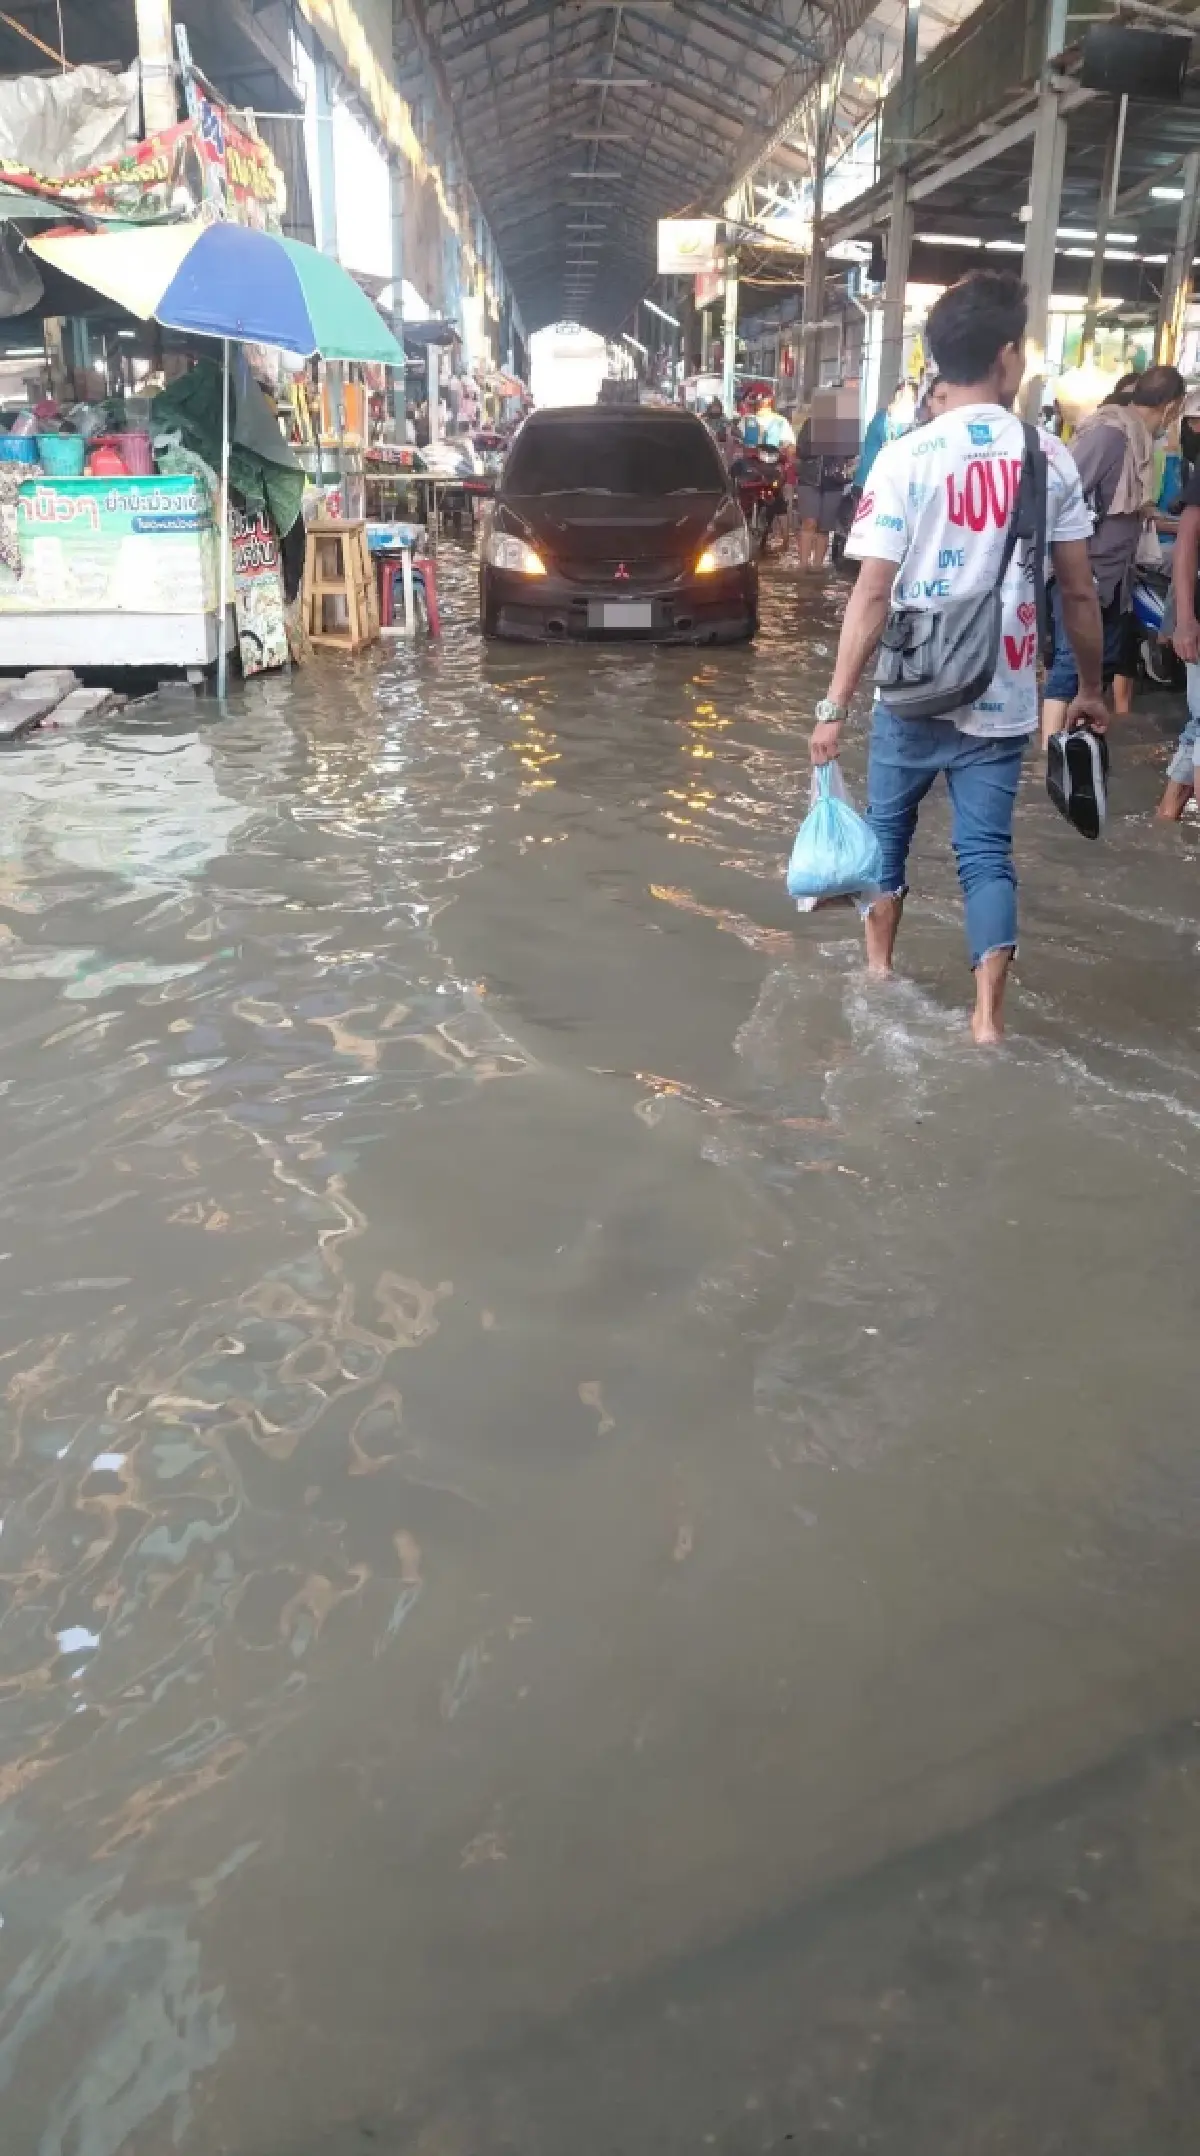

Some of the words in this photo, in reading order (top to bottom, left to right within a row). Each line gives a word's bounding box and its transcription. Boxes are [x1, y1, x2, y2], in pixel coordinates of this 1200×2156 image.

[912, 437, 947, 457] LOVE
[938, 549, 965, 568] LOVE
[900, 578, 952, 599] LOVE
